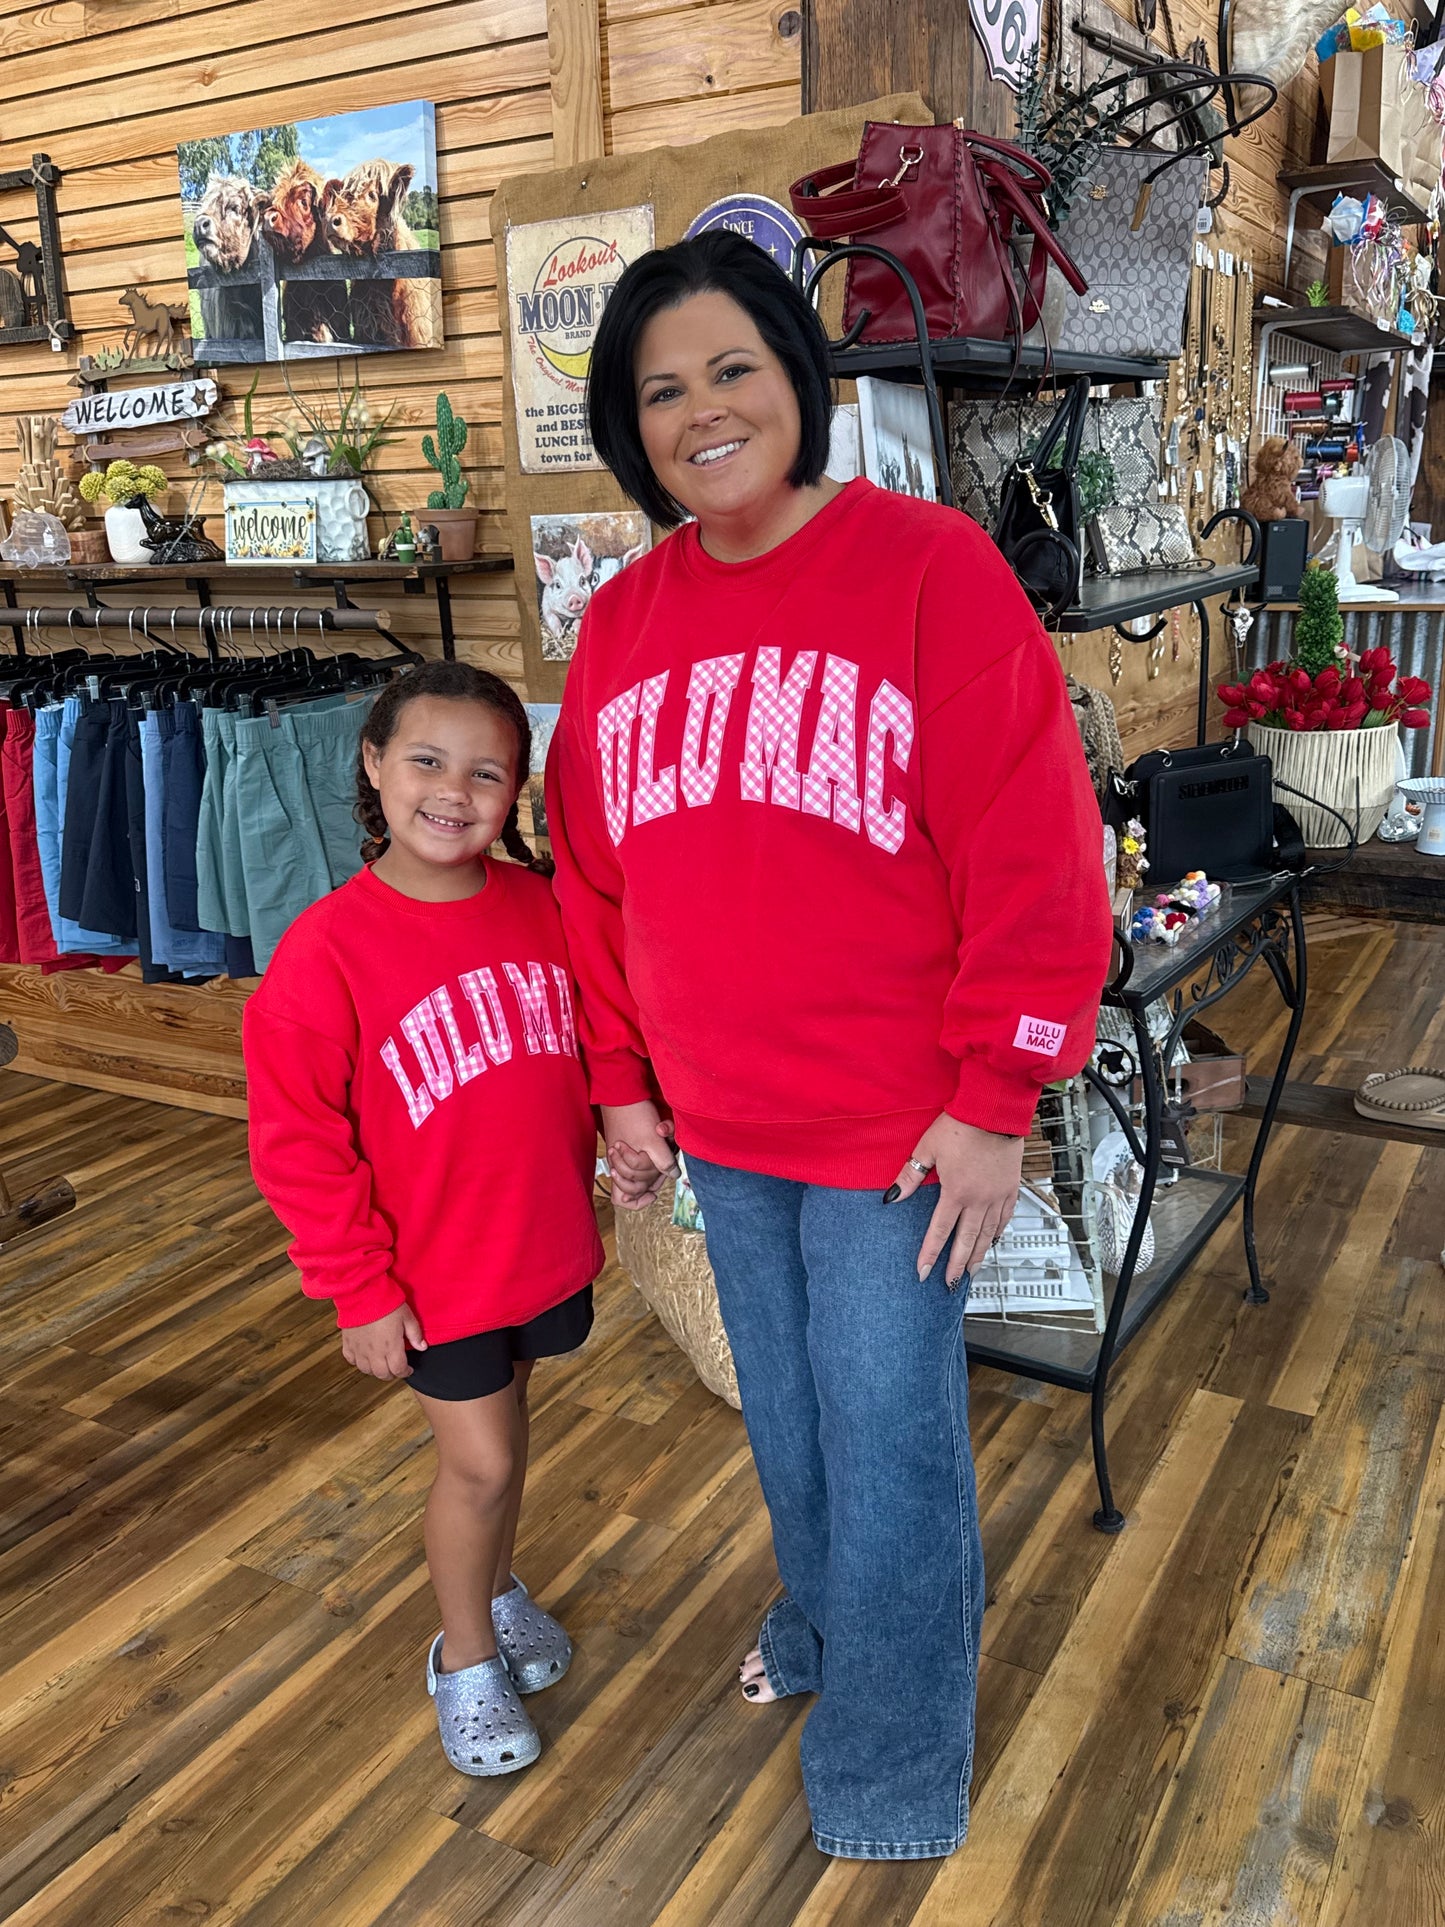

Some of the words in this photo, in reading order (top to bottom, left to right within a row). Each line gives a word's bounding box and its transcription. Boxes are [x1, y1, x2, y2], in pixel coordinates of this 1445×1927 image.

[722, 219, 755, 235] SINCE
[543, 239, 618, 289] Lookout
[565, 329, 592, 340] BRAND
[527, 335, 537, 355] The
[535, 356, 563, 386] Original
[75, 389, 185, 425] WELCOME
[525, 406, 545, 418] the
[547, 403, 588, 417] BIGGE
[536, 421, 558, 433] and
[535, 435, 578, 448] LUNCH
[581, 435, 594, 446] in
[540, 452, 572, 464] town
[574, 451, 593, 462] for
[233, 508, 308, 541] welcome
[597, 652, 746, 849] ULU
[739, 646, 915, 856] MAC
[1027, 1021, 1062, 1039] LULU
[379, 965, 514, 1131] LULU
[501, 960, 580, 1062] MA
[1026, 1034, 1056, 1050] MAC
